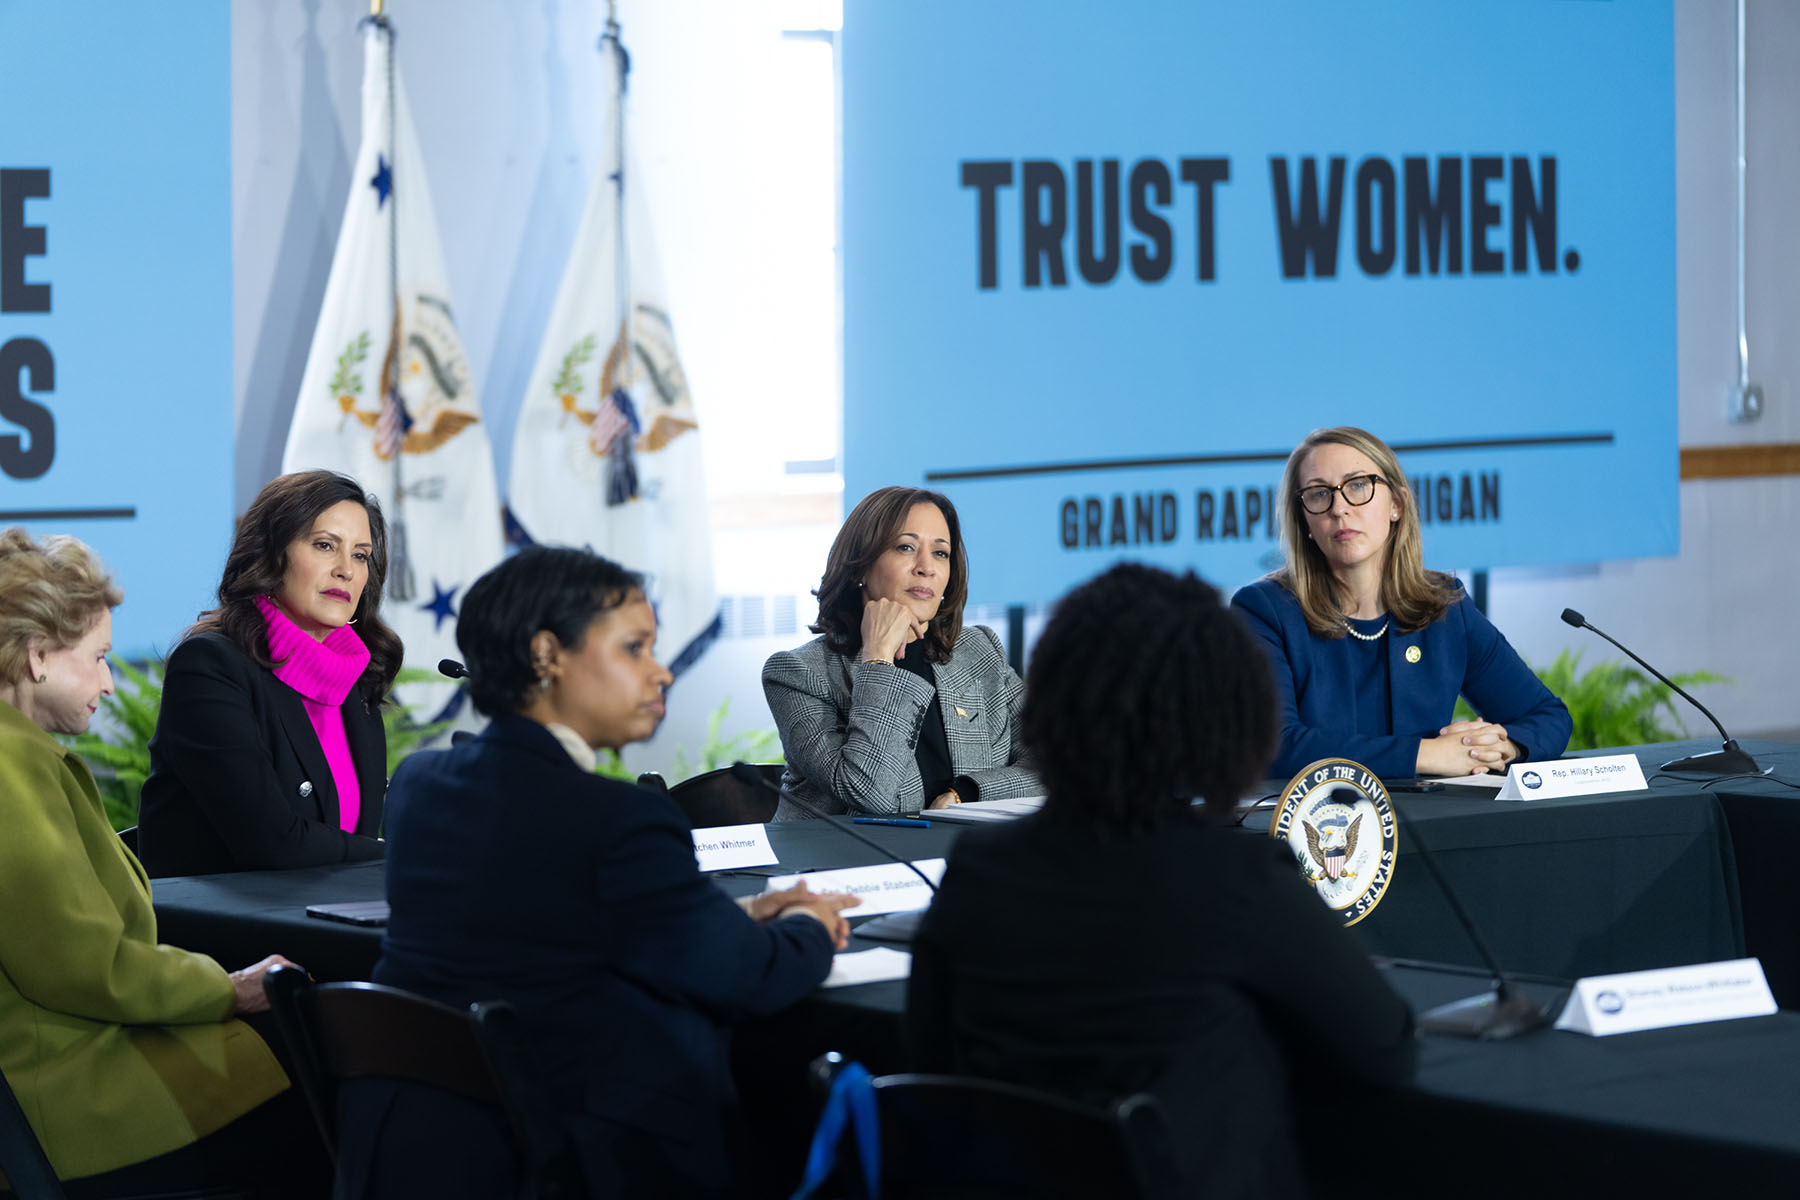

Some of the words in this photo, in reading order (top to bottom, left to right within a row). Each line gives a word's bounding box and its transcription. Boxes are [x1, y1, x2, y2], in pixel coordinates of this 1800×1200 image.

[960, 156, 1231, 290] TRUST
[1269, 153, 1582, 280] WOMEN.
[1060, 492, 1178, 549] GRAND
[1196, 489, 1274, 540] RAPI
[1314, 768, 1329, 783] OF
[1333, 766, 1356, 780] THE
[1551, 768, 1569, 778] Rep.
[1570, 767, 1593, 777] Hillary
[1594, 764, 1626, 775] Scholten
[1360, 772, 1394, 839] UNITED
[720, 839, 756, 849] Whitmer
[1356, 850, 1393, 915] STATES
